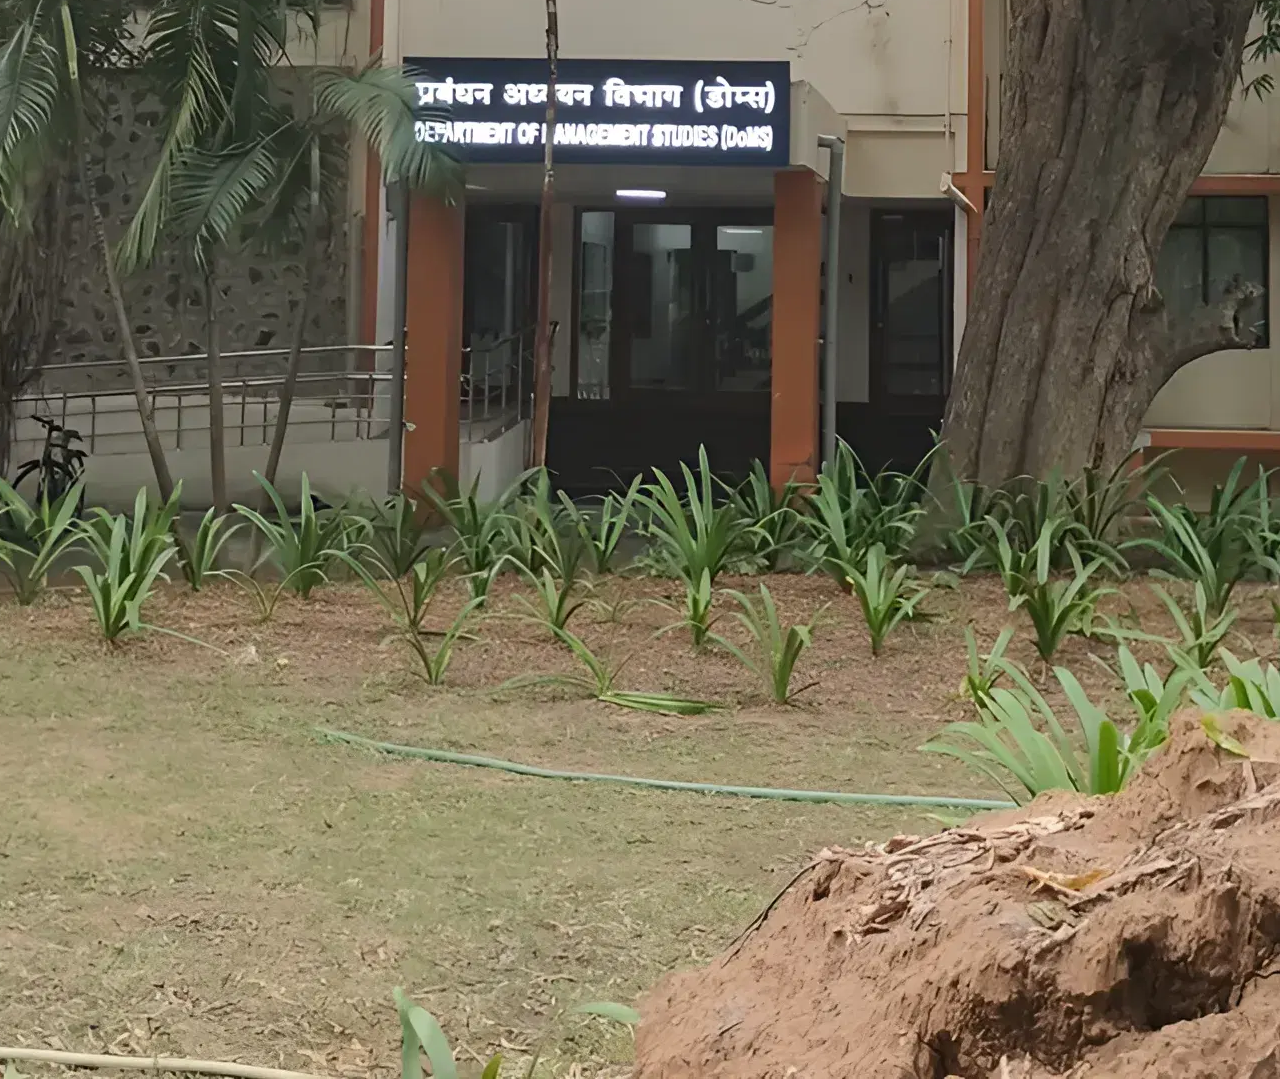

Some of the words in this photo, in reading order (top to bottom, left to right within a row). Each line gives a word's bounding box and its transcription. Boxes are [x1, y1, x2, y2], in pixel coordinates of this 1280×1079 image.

[414, 76, 494, 106] प्रबंधन
[602, 77, 684, 108] विभाग
[694, 75, 776, 114] (डोम्स)
[414, 121, 516, 145] DEPARTMENT
[517, 122, 540, 144] OF
[651, 124, 719, 147] STUDIES
[721, 124, 774, 152] (DoMS)
